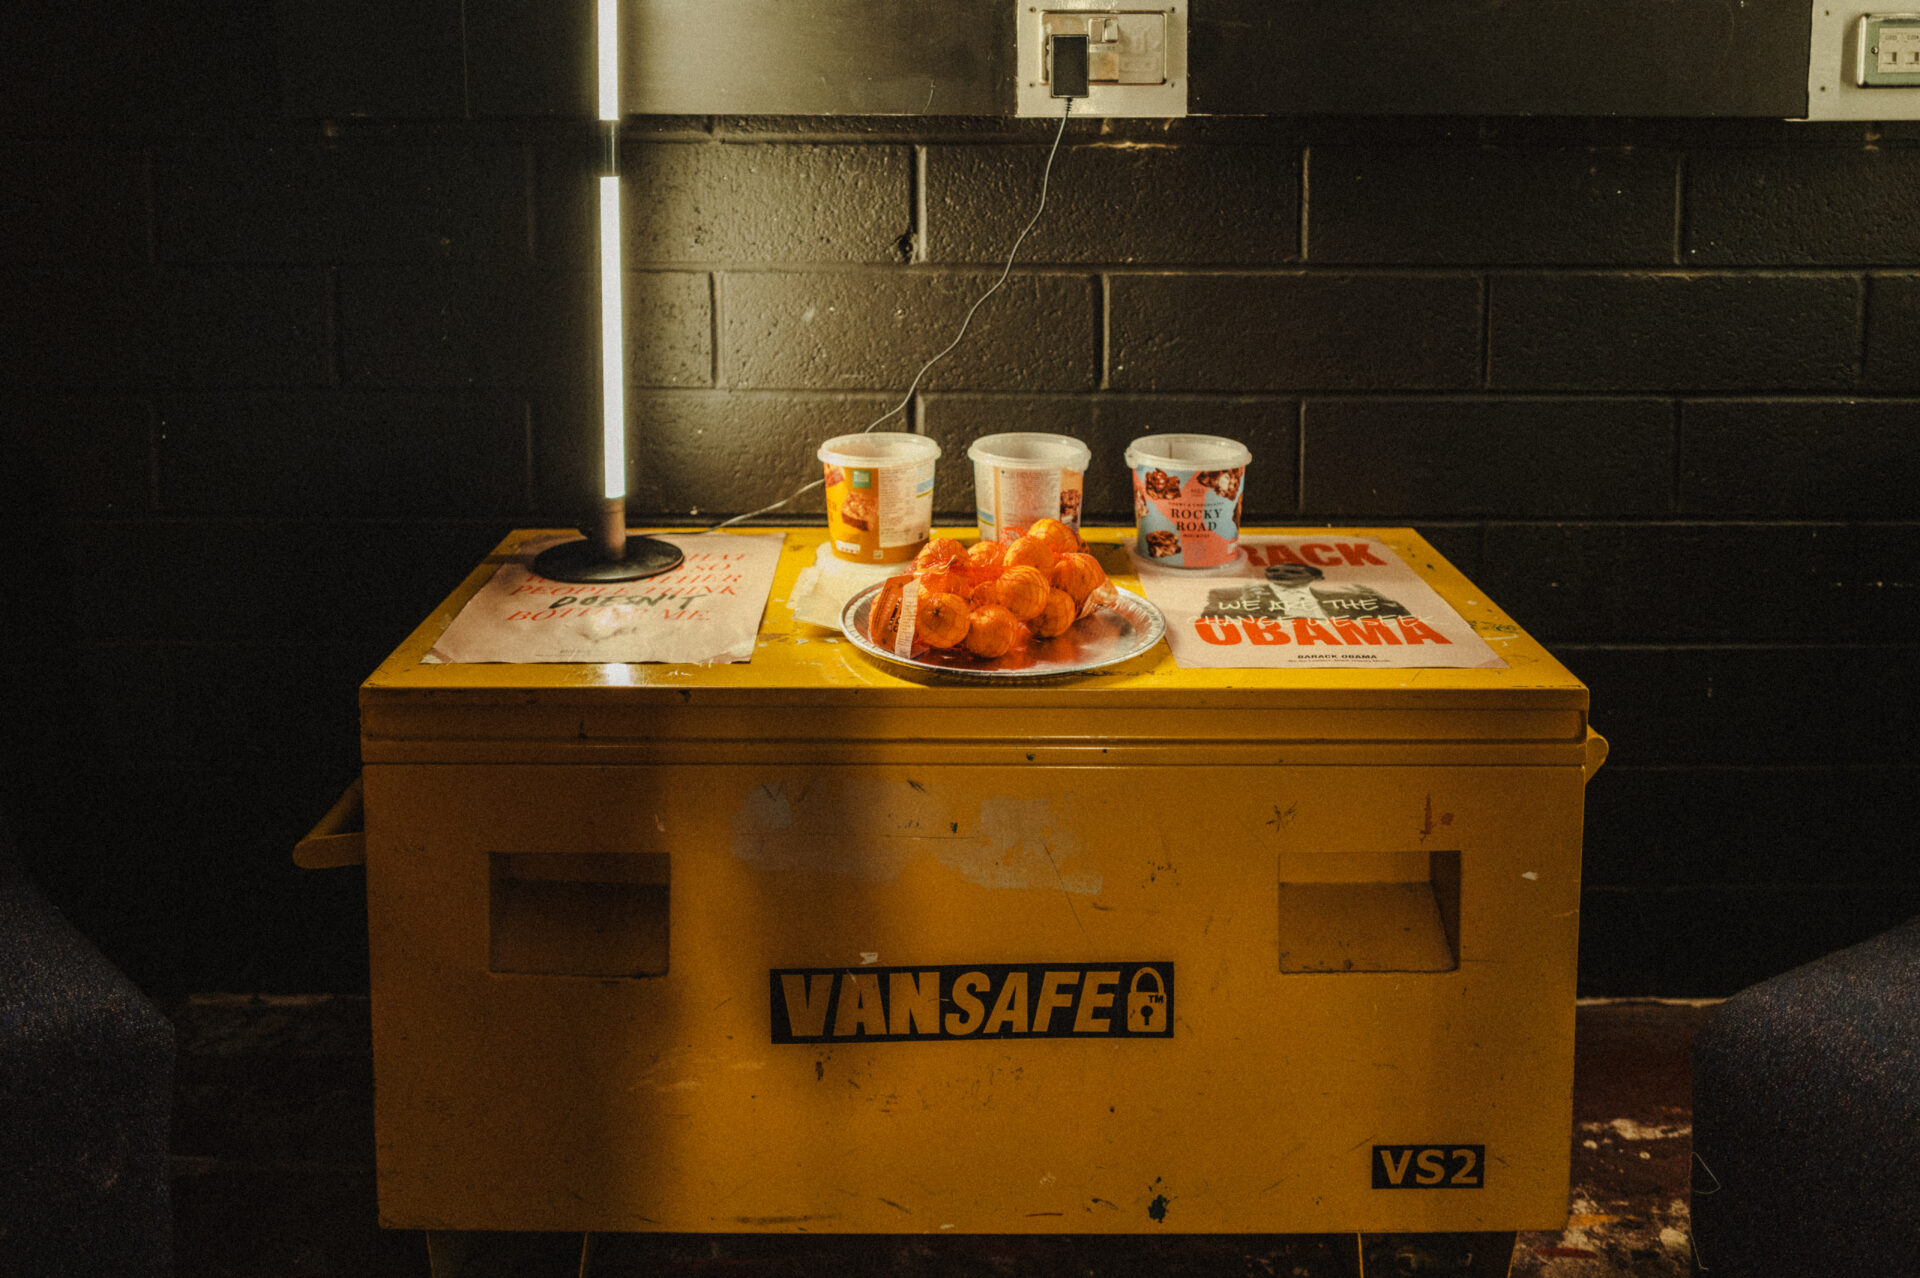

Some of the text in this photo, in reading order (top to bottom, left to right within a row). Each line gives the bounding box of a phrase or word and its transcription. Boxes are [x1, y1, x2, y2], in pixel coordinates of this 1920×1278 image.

[1170, 508, 1222, 519] ROCKY
[1176, 521, 1217, 531] ROAD
[687, 553, 753, 561] HAT
[1239, 543, 1388, 566] RACK
[510, 585, 630, 596] PEOPLE
[644, 585, 737, 597] THINK
[548, 592, 707, 610] DOESN'T
[1219, 598, 1378, 611] WE ARE THE
[1187, 614, 1297, 627] CHANGE
[1306, 614, 1350, 627] WE
[1193, 617, 1453, 647] OBAMA
[780, 971, 1121, 1036] VANSAFE
[1379, 1148, 1478, 1185] VS2
